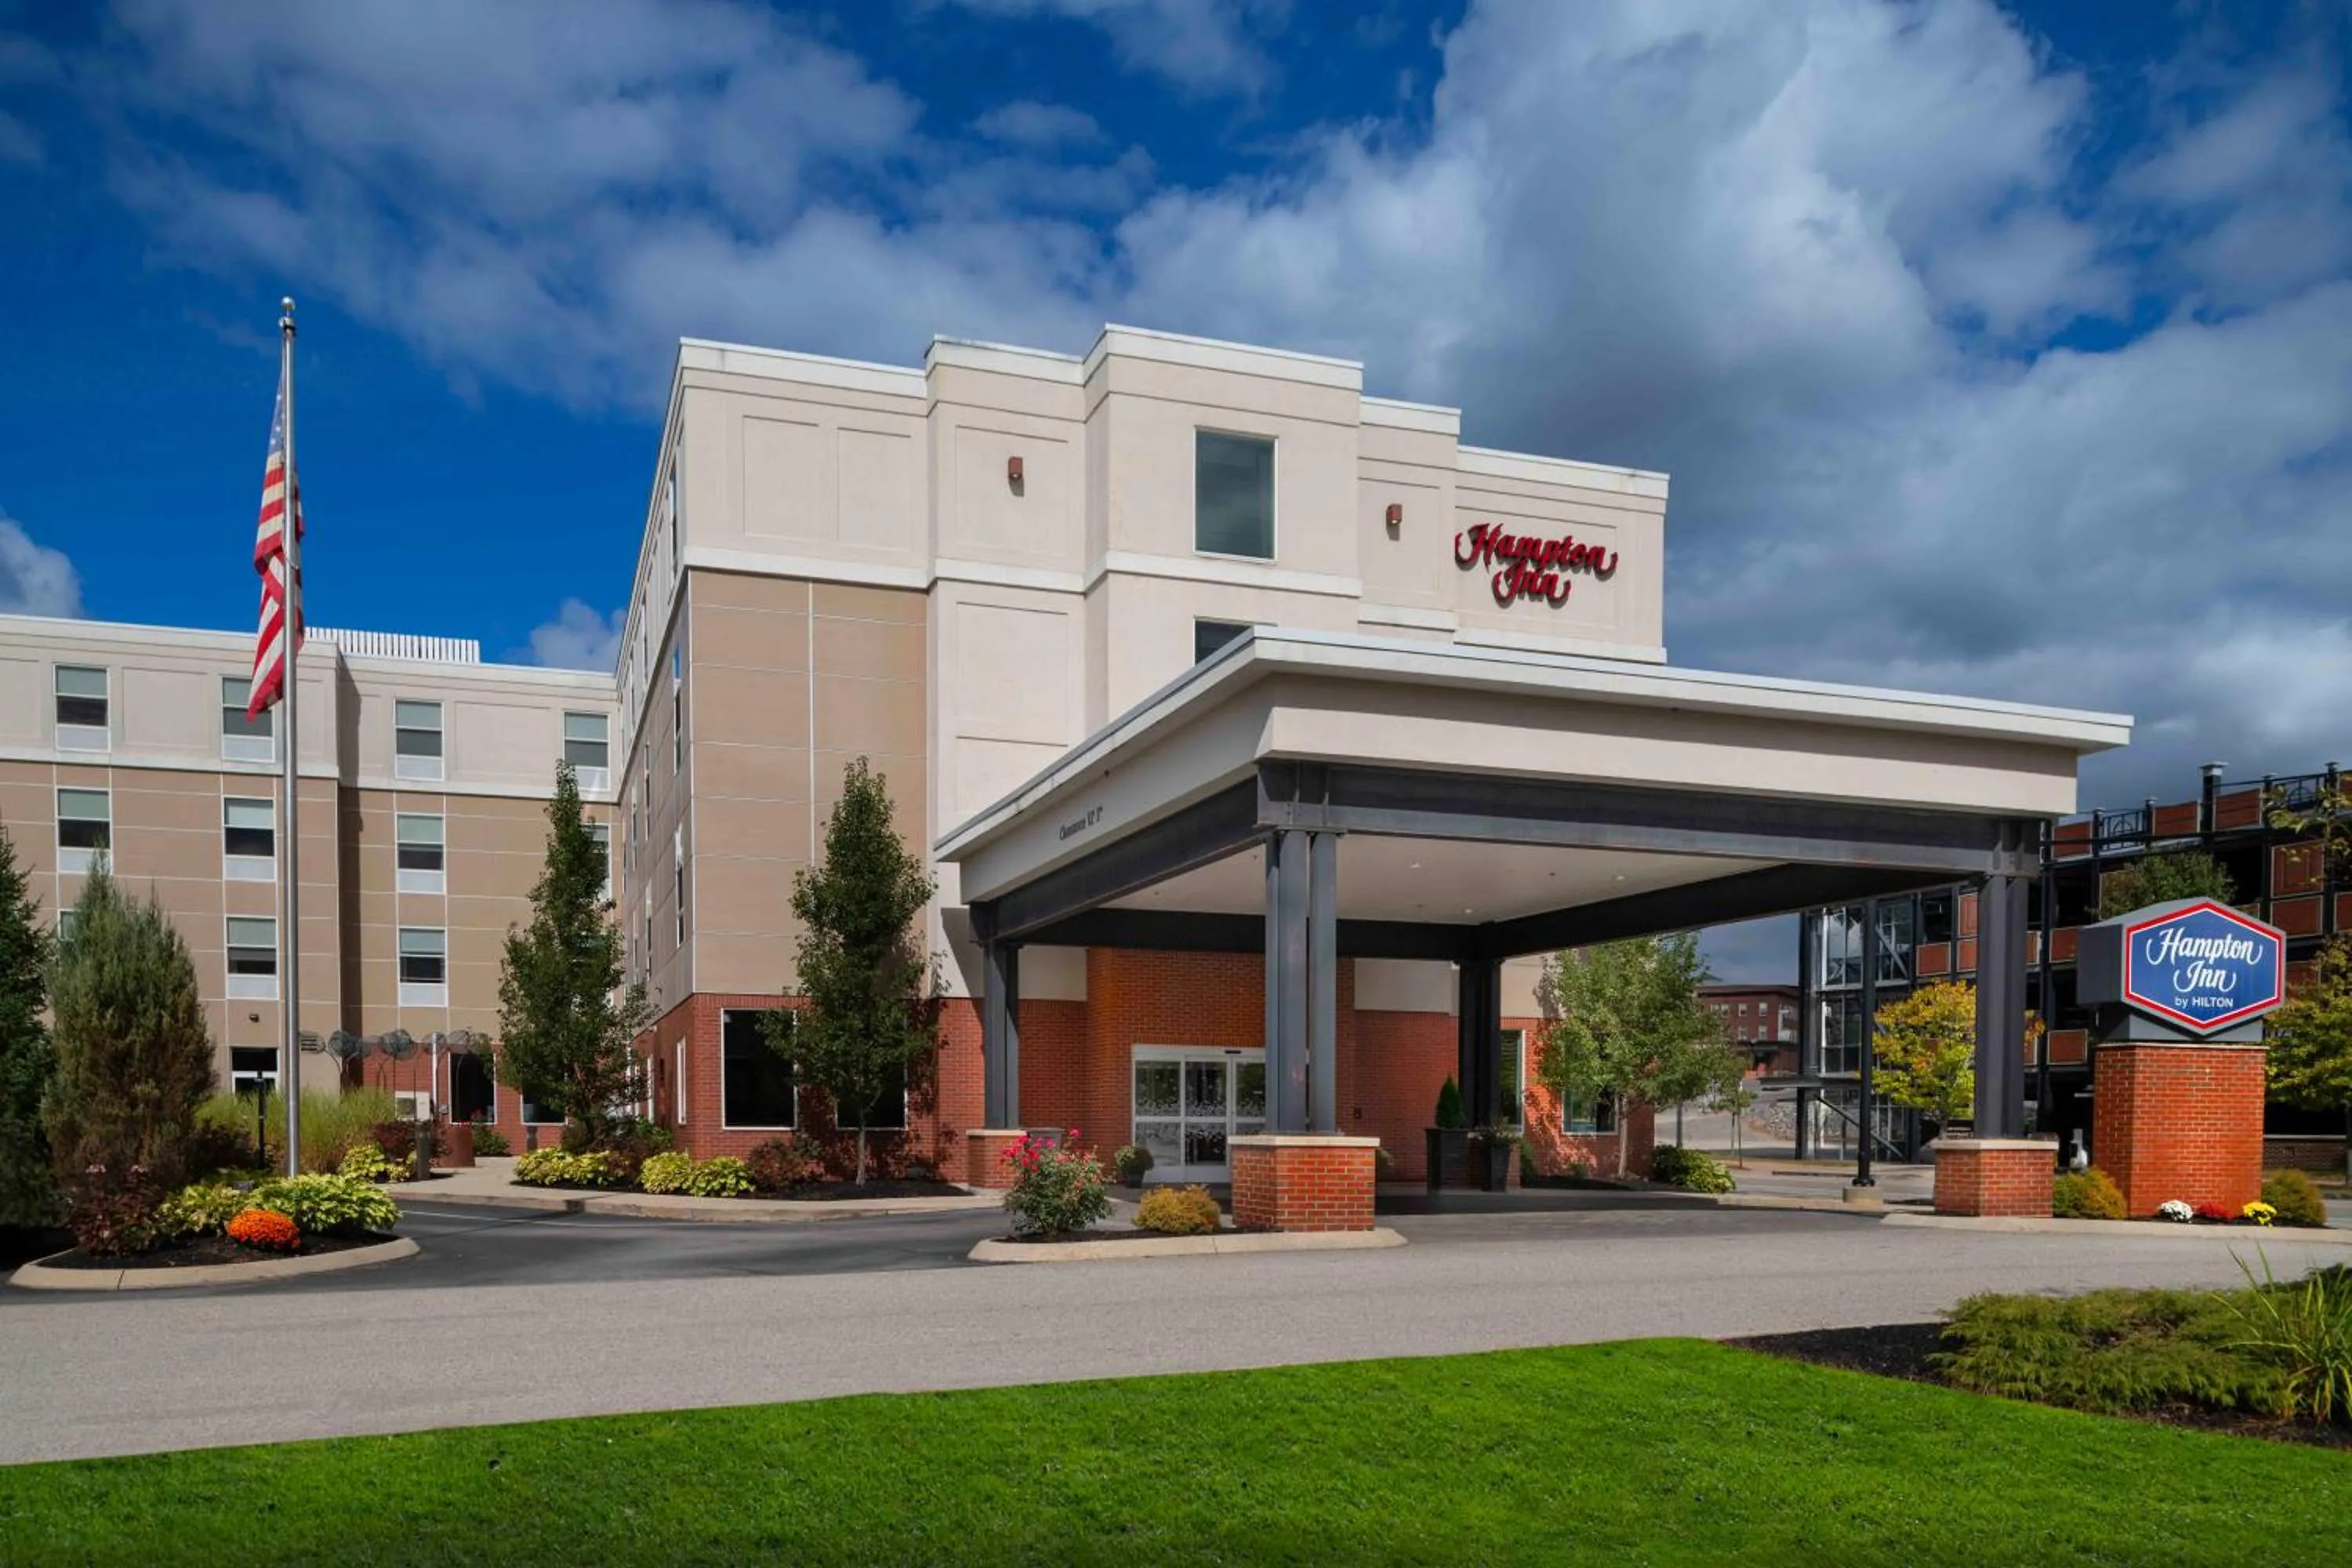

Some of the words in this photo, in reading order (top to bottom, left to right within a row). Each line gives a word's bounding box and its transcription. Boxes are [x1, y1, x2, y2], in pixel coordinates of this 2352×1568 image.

[1454, 523, 1618, 579] Hampton
[1491, 557, 1571, 606] Inn
[2146, 926, 2263, 966] Hampton
[2172, 960, 2237, 993] Inn
[2174, 996, 2188, 1009] by
[2192, 996, 2234, 1007] HILTON
